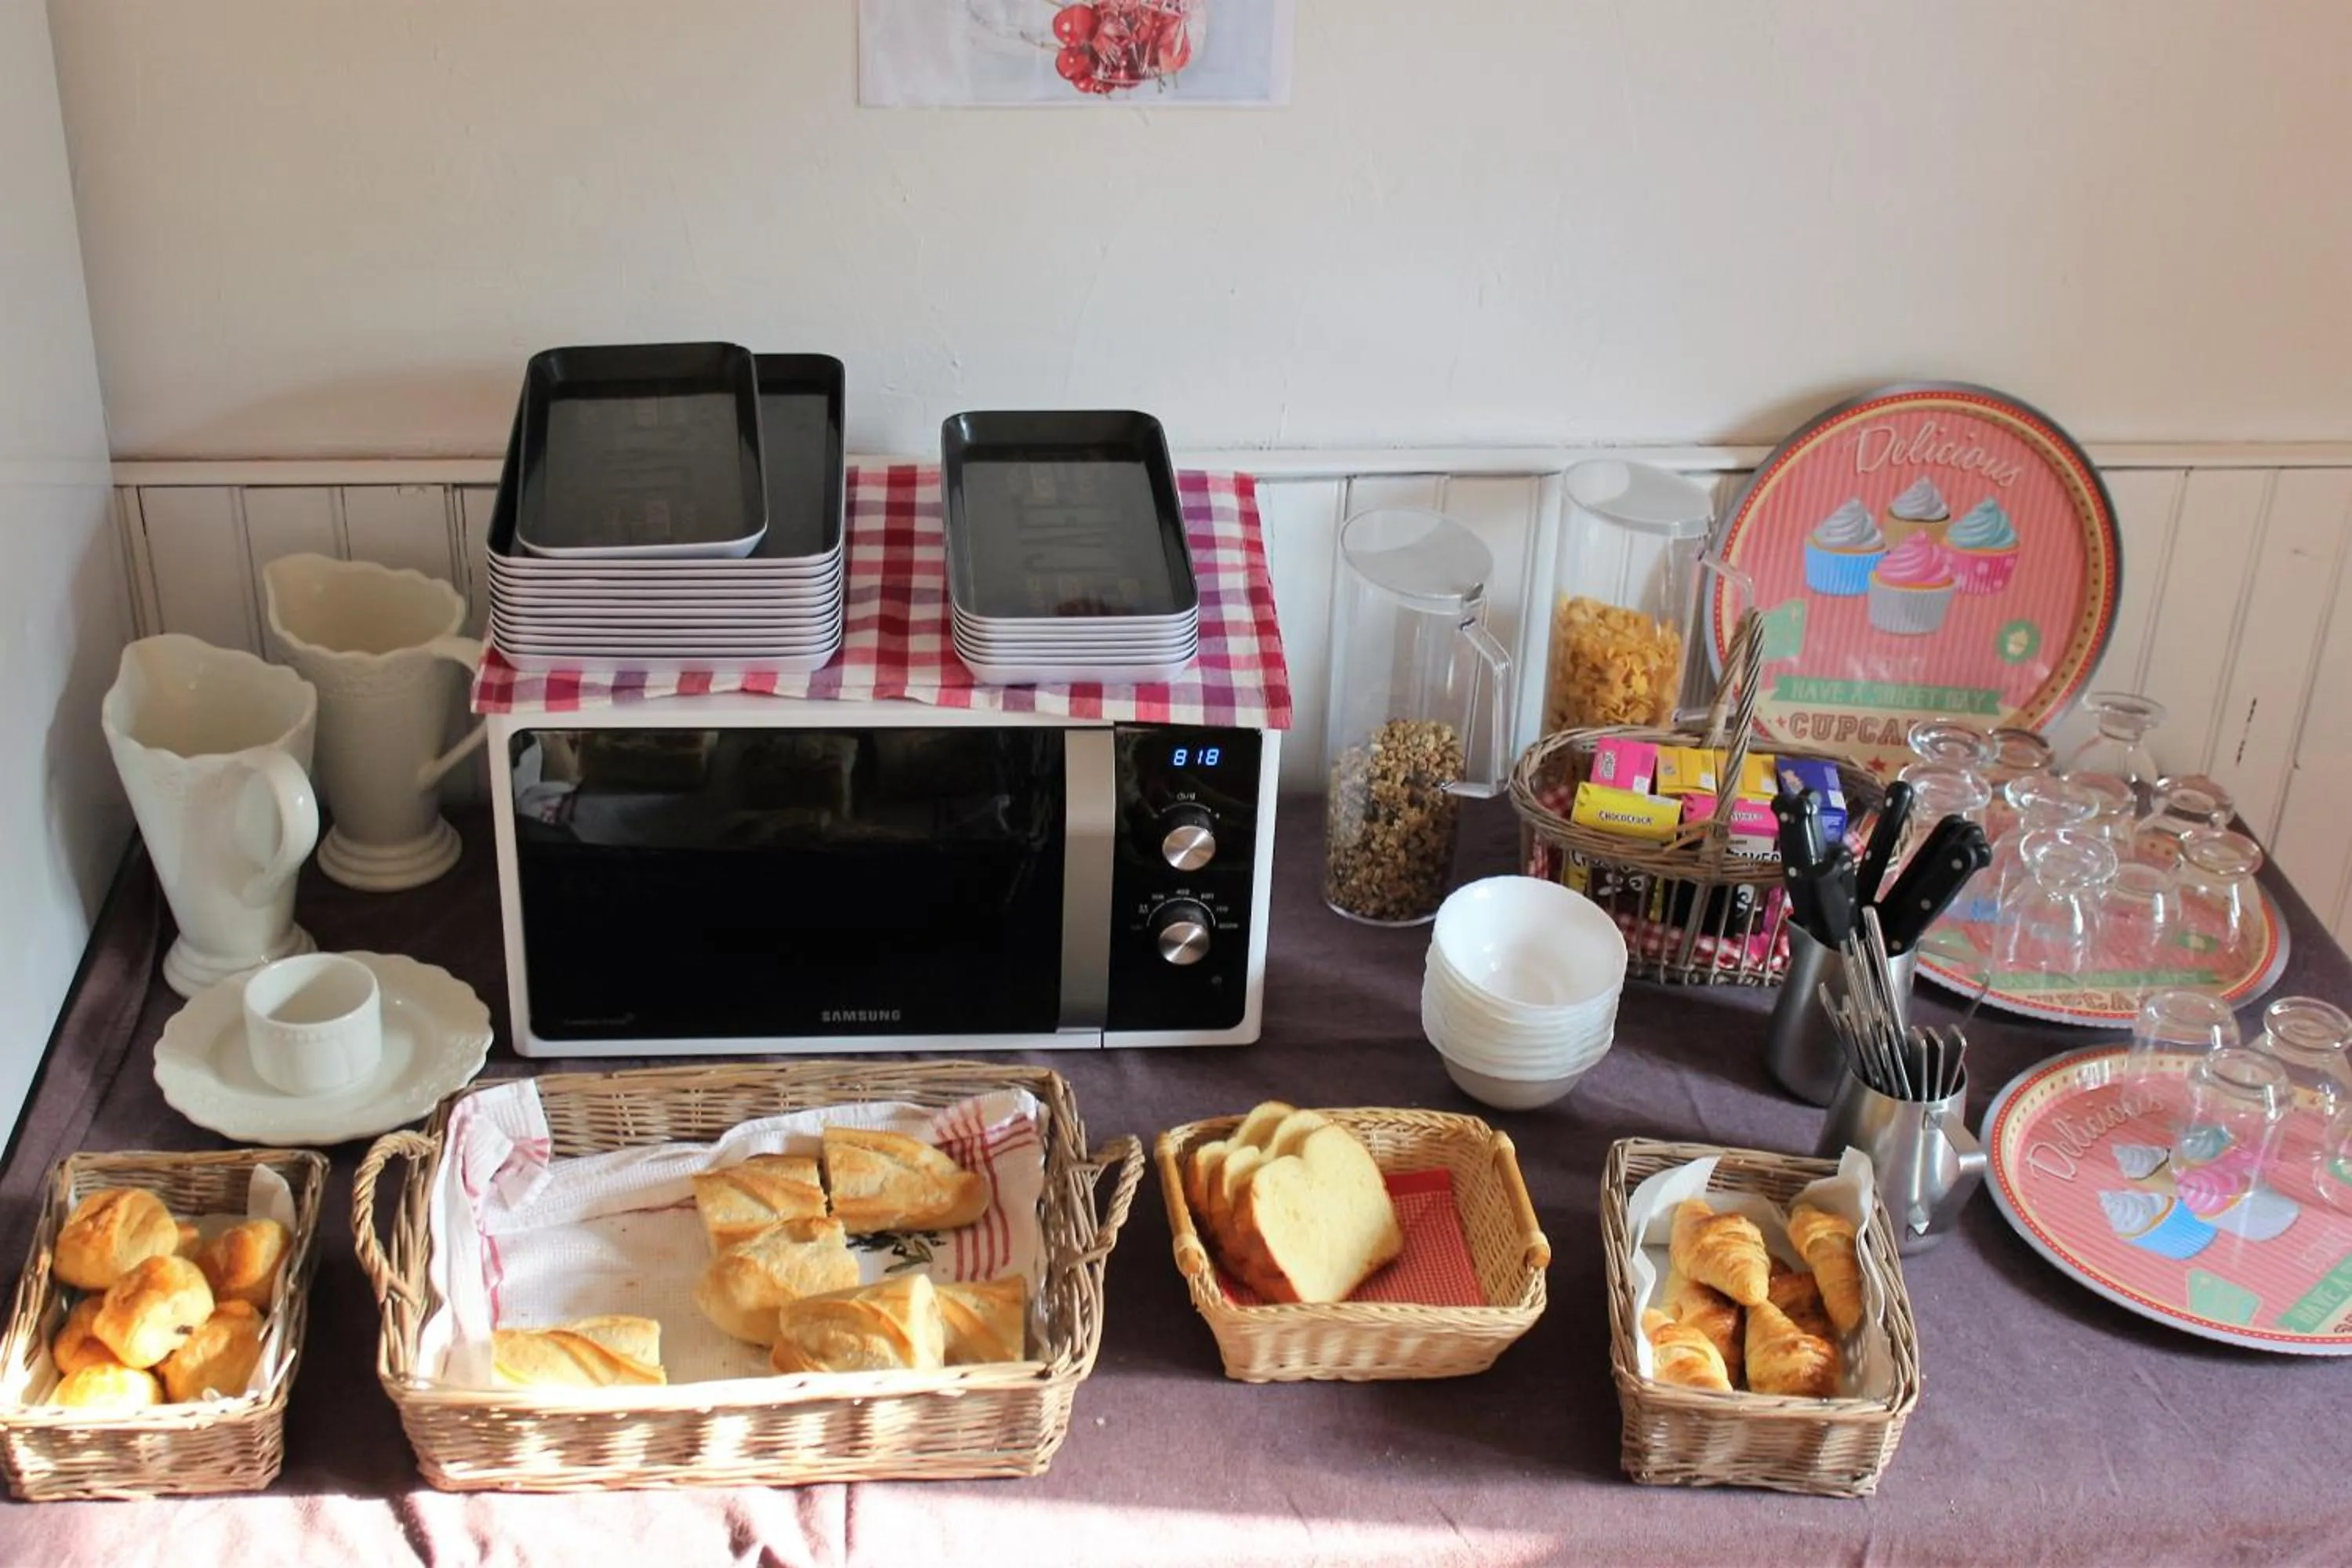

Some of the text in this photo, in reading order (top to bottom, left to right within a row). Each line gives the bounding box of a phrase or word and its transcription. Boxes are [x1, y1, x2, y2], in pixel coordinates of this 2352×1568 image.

[1857, 420, 2021, 487] Delicious
[1791, 680, 1841, 701] HAVE
[1848, 683, 1864, 702] A
[1945, 689, 1986, 710] DAY
[1788, 712, 1919, 746] CUPCA
[822, 1009, 901, 1022] SAMSUNG
